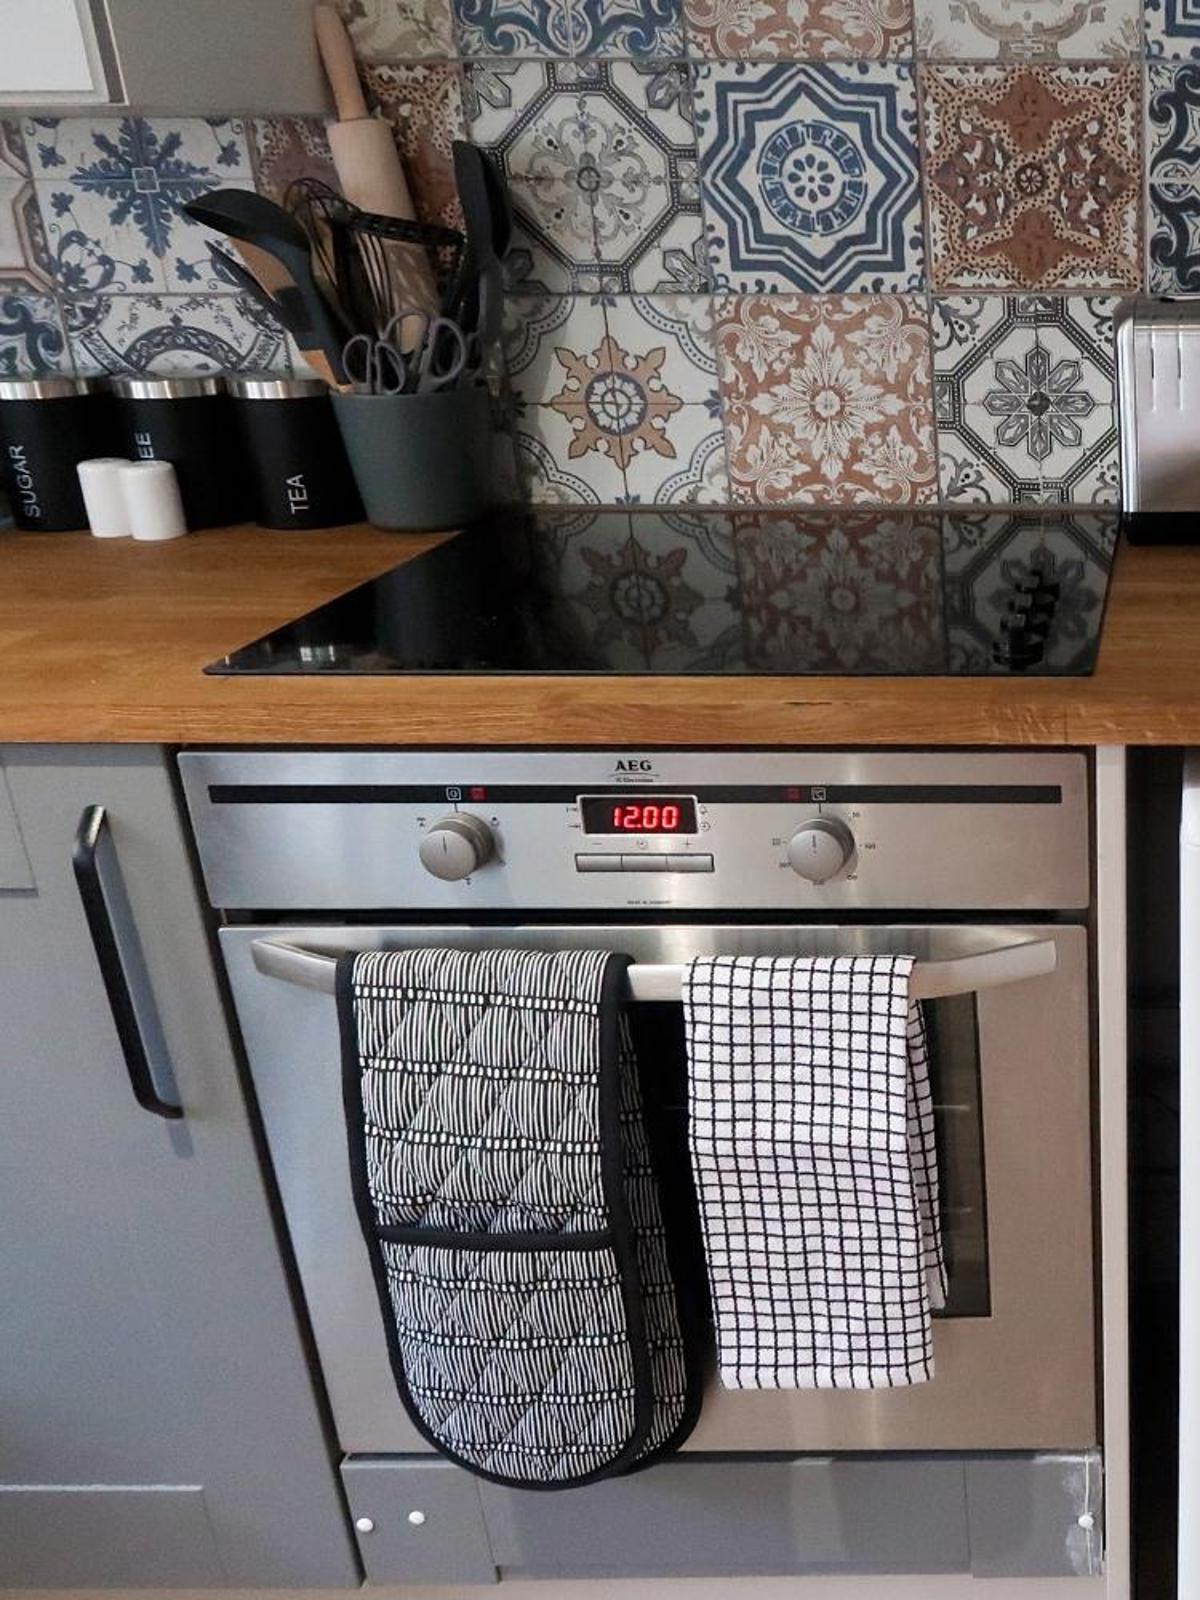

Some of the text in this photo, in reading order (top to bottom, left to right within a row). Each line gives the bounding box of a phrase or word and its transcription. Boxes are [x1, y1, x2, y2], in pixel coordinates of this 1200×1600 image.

[9, 446, 40, 517] SUGAR
[286, 474, 310, 515] TEA
[615, 760, 653, 772] AEG
[613, 806, 679, 829] 12.00
